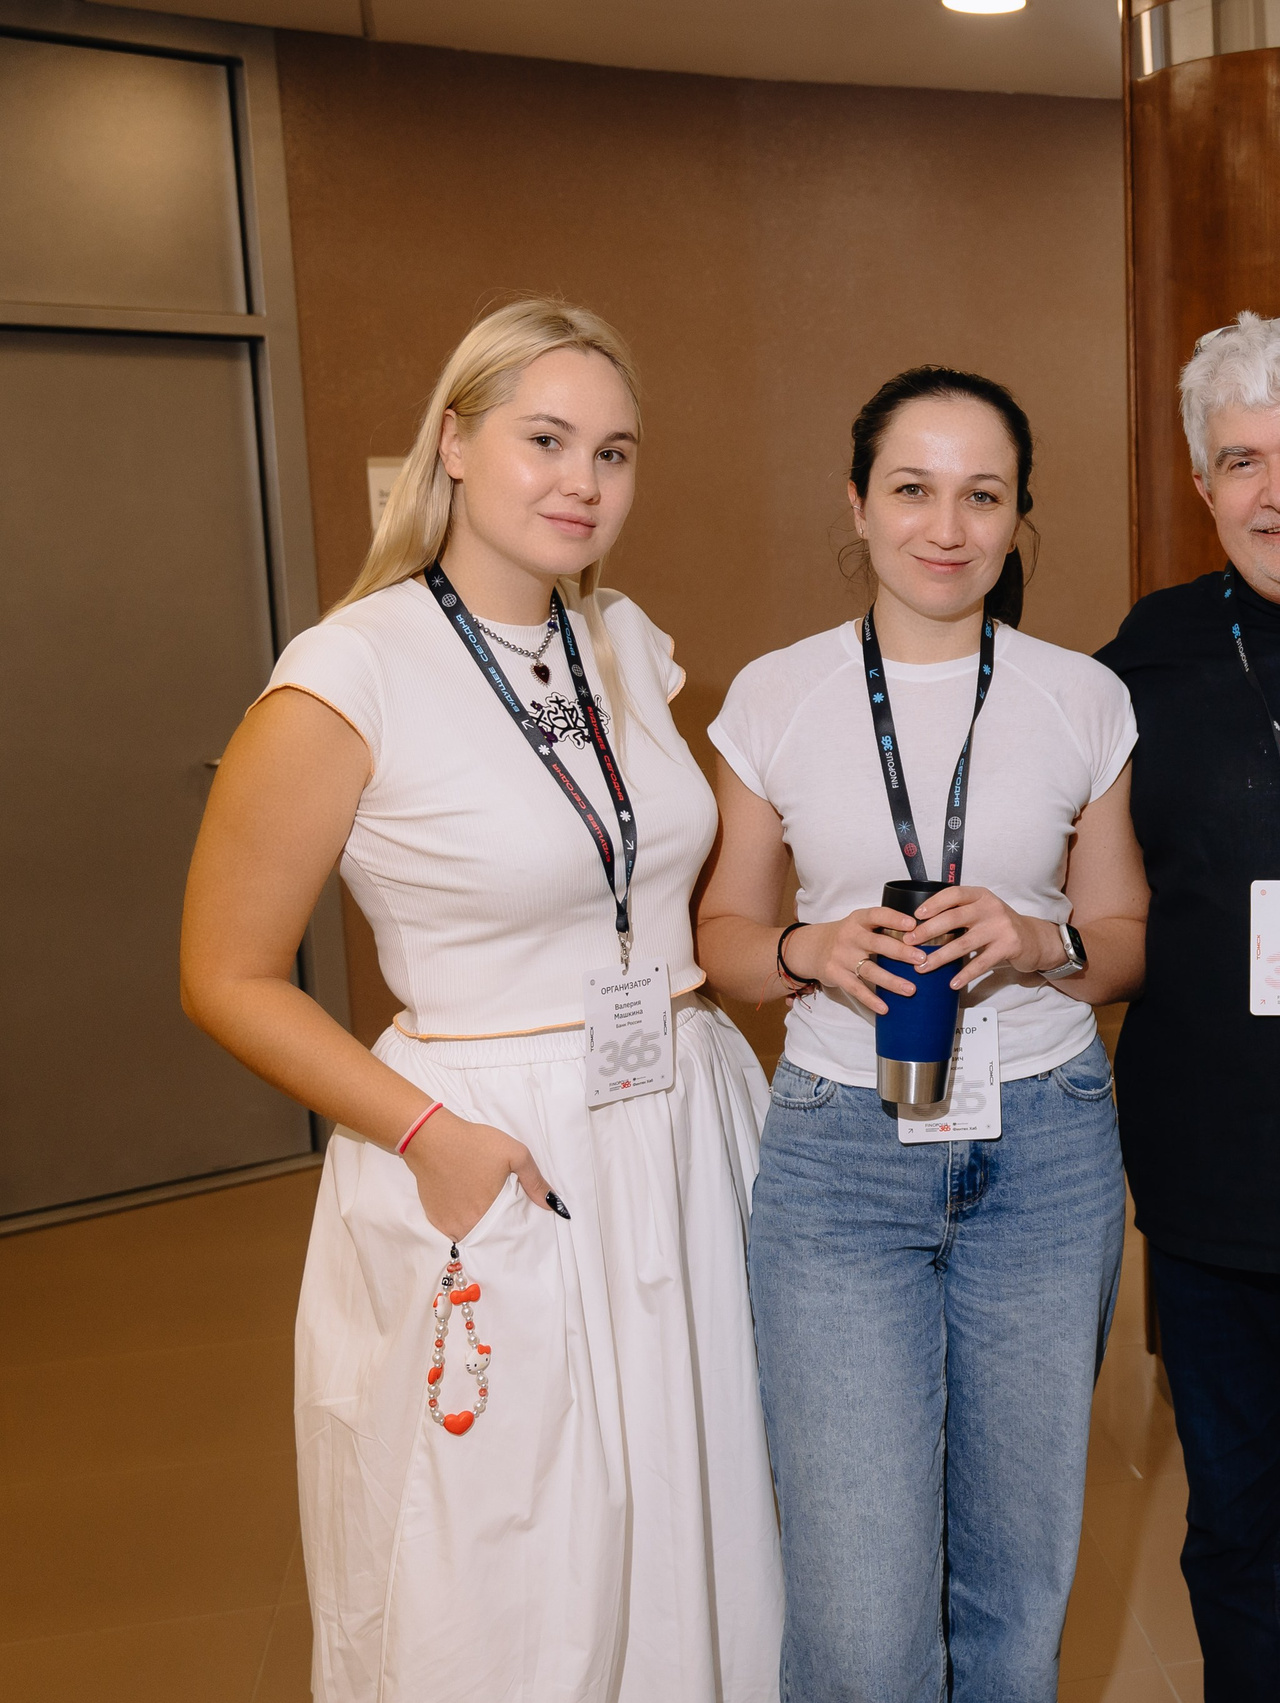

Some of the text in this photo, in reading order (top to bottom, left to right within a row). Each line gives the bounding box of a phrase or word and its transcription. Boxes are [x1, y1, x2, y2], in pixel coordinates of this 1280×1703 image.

[455, 614, 520, 713] БУДУЩЕЕ СЕГОДНЯ
[587, 706, 624, 801] БУДУЩЕЕ СЕГОДНЯ
[881, 735, 899, 789] FINOPOLIS 365
[552, 763, 587, 810] СЕГОДНЯ
[953, 757, 965, 807] СЕГОДНЯ
[586, 813, 611, 862] БУДУЩЕЕ
[601, 978, 651, 995] ОРГАНИЗАТОР
[614, 1000, 641, 1011] Валерия
[614, 1009, 643, 1020] Машкина
[598, 1028, 662, 1077] 365
